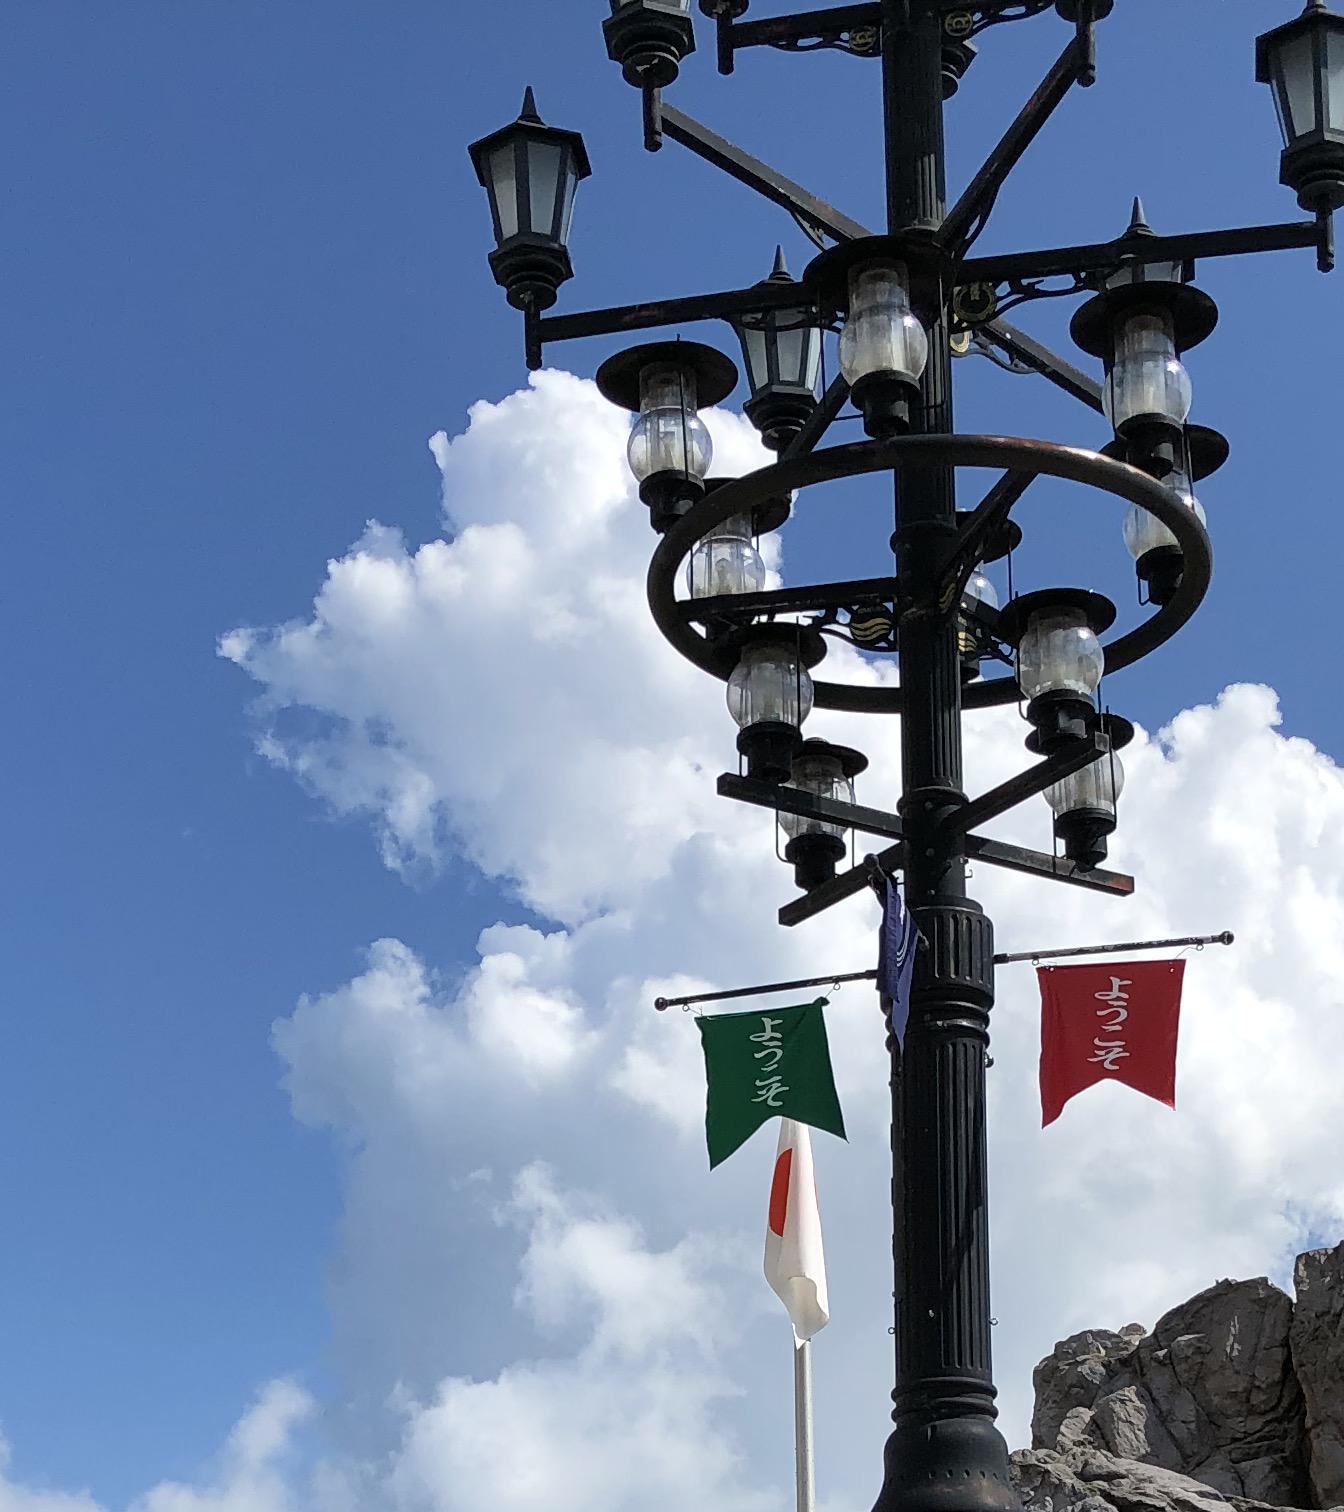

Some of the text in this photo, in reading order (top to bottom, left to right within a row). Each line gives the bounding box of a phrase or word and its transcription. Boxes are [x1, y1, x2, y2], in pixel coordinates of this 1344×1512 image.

[749, 1017, 790, 1107] ようこそ
[1086, 976, 1133, 1070] ようこそ
